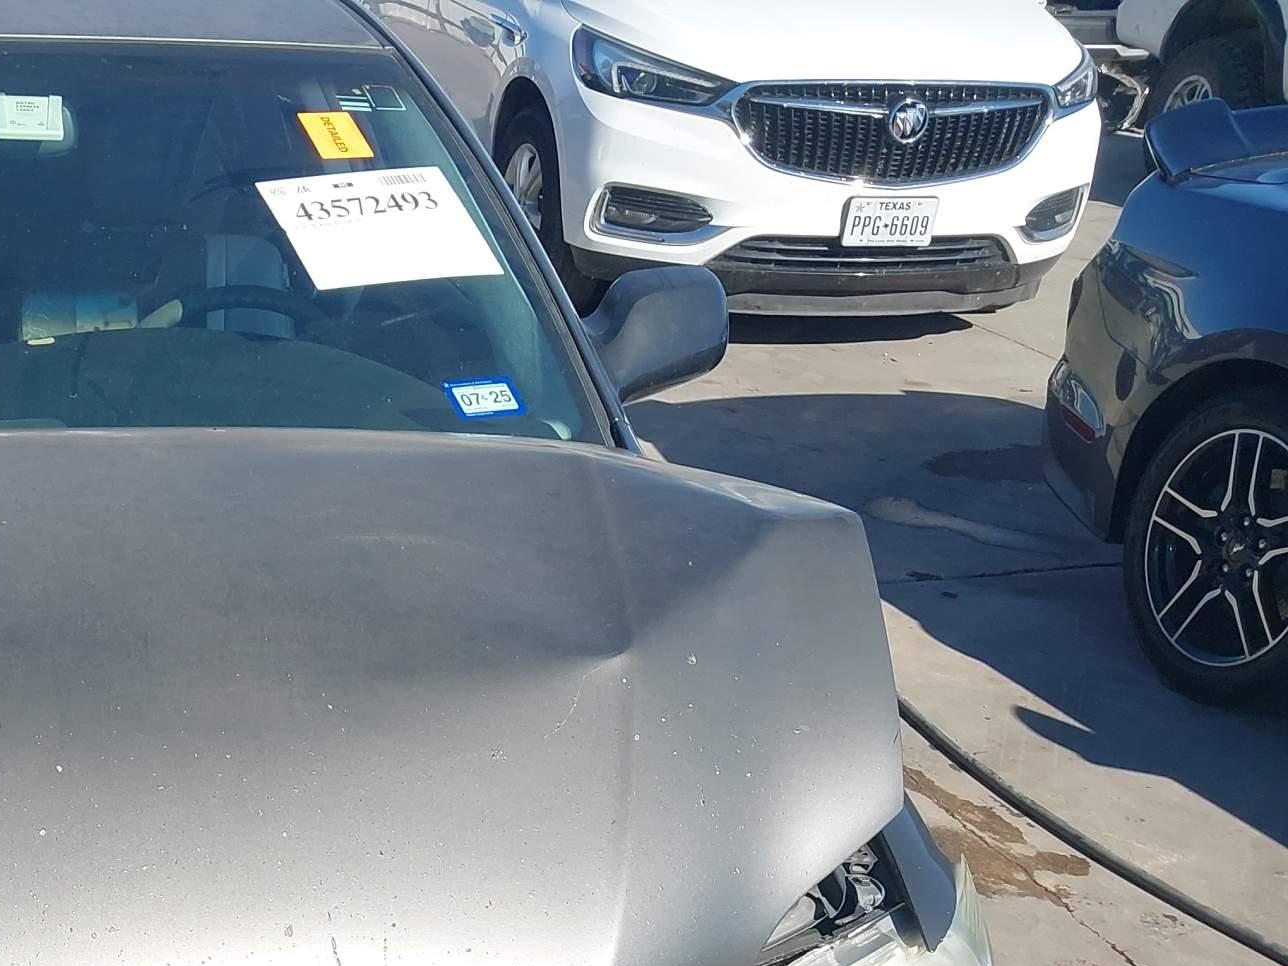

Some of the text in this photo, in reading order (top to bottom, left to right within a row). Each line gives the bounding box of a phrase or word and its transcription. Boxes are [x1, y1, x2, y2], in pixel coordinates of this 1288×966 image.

[320, 116, 349, 153] DETAILED
[295, 191, 439, 221] 43572493
[879, 201, 912, 211] TEXAS
[460, 390, 512, 407] 07 25
